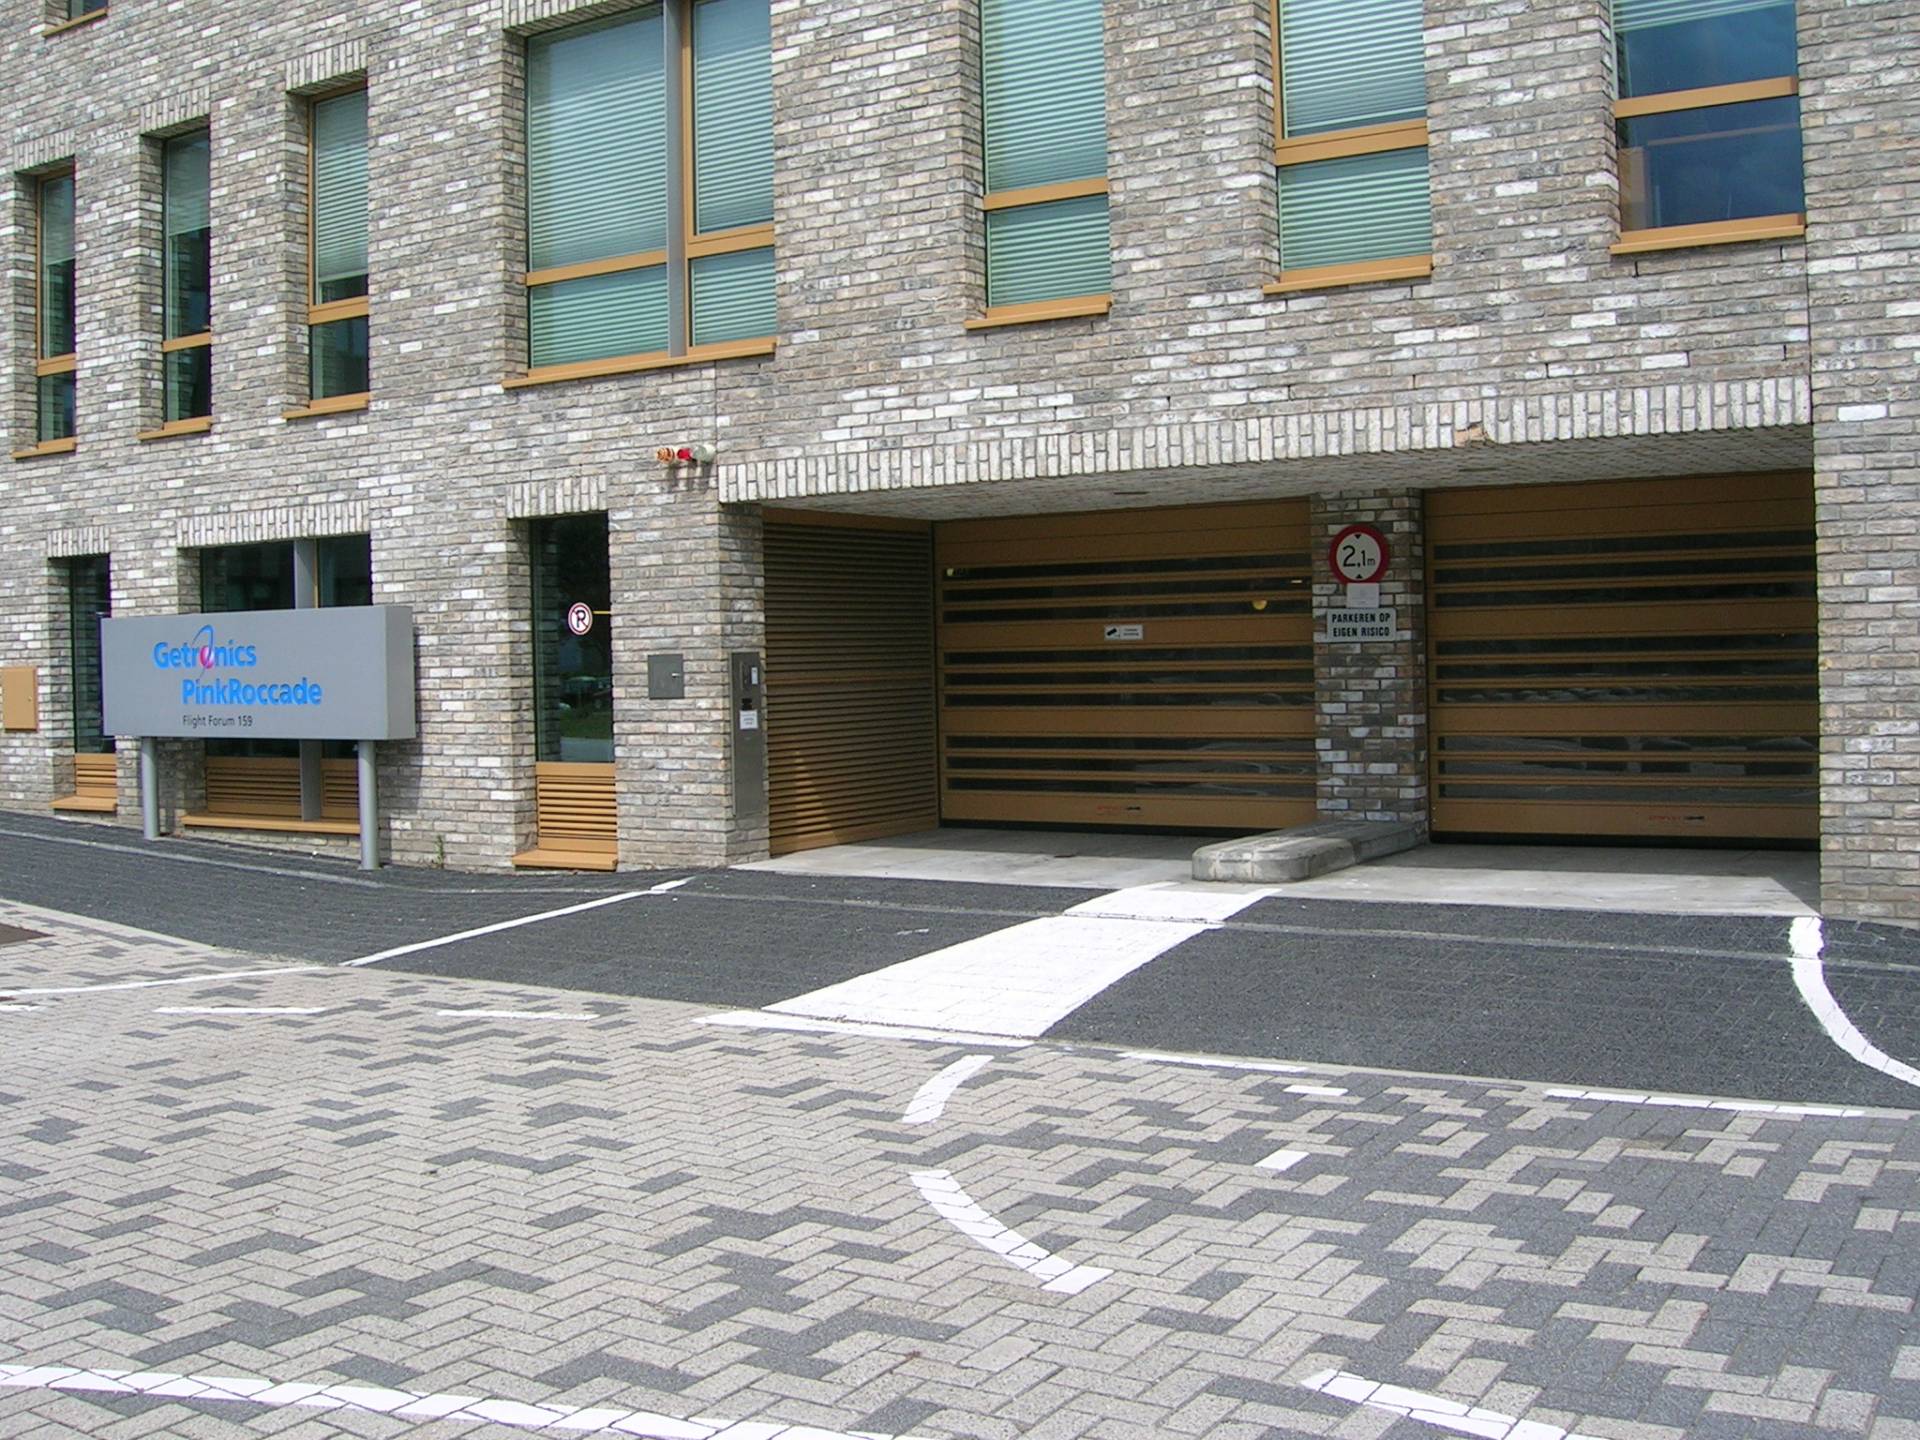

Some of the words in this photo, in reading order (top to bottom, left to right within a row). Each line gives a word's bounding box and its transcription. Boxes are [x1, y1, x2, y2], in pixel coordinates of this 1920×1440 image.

[1331, 612, 1376, 624] PARKEREN
[1378, 612, 1391, 623] OP
[1332, 627, 1358, 638] EIGEN
[1360, 626, 1390, 637] RISICO
[153, 637, 258, 669] Getronics
[182, 677, 323, 705] PinkRoccade
[182, 714, 207, 729] Flight
[208, 714, 236, 727] Forum
[237, 714, 254, 727] 159
